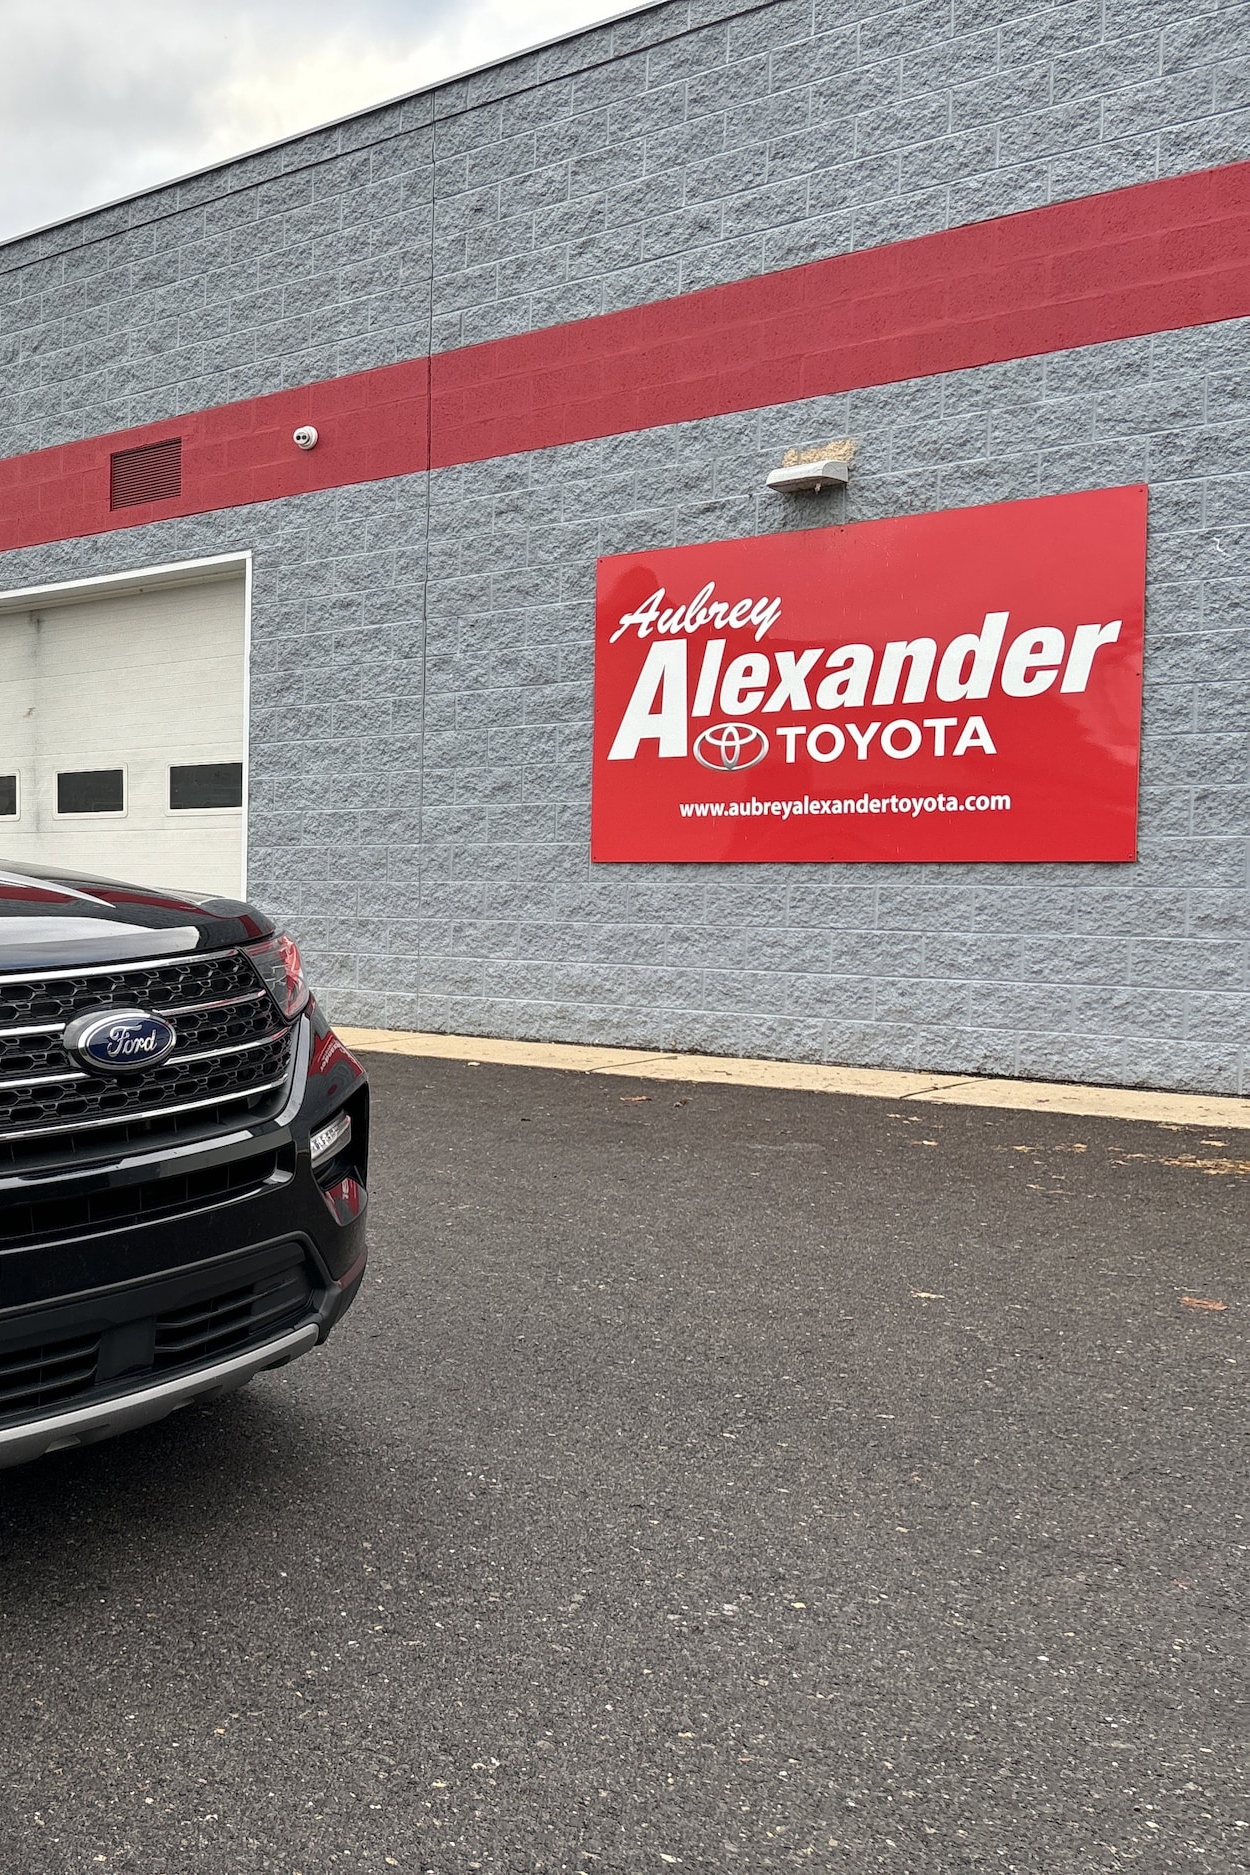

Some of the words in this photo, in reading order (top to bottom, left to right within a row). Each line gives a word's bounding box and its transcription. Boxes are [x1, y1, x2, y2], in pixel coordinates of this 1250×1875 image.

[609, 581, 782, 642] Aubrey
[607, 611, 1122, 761] Alexander
[777, 716, 998, 763] TOYOTA
[679, 793, 1012, 820] www.aubreyalexandertoyota.com
[107, 1024, 157, 1058] Ford
